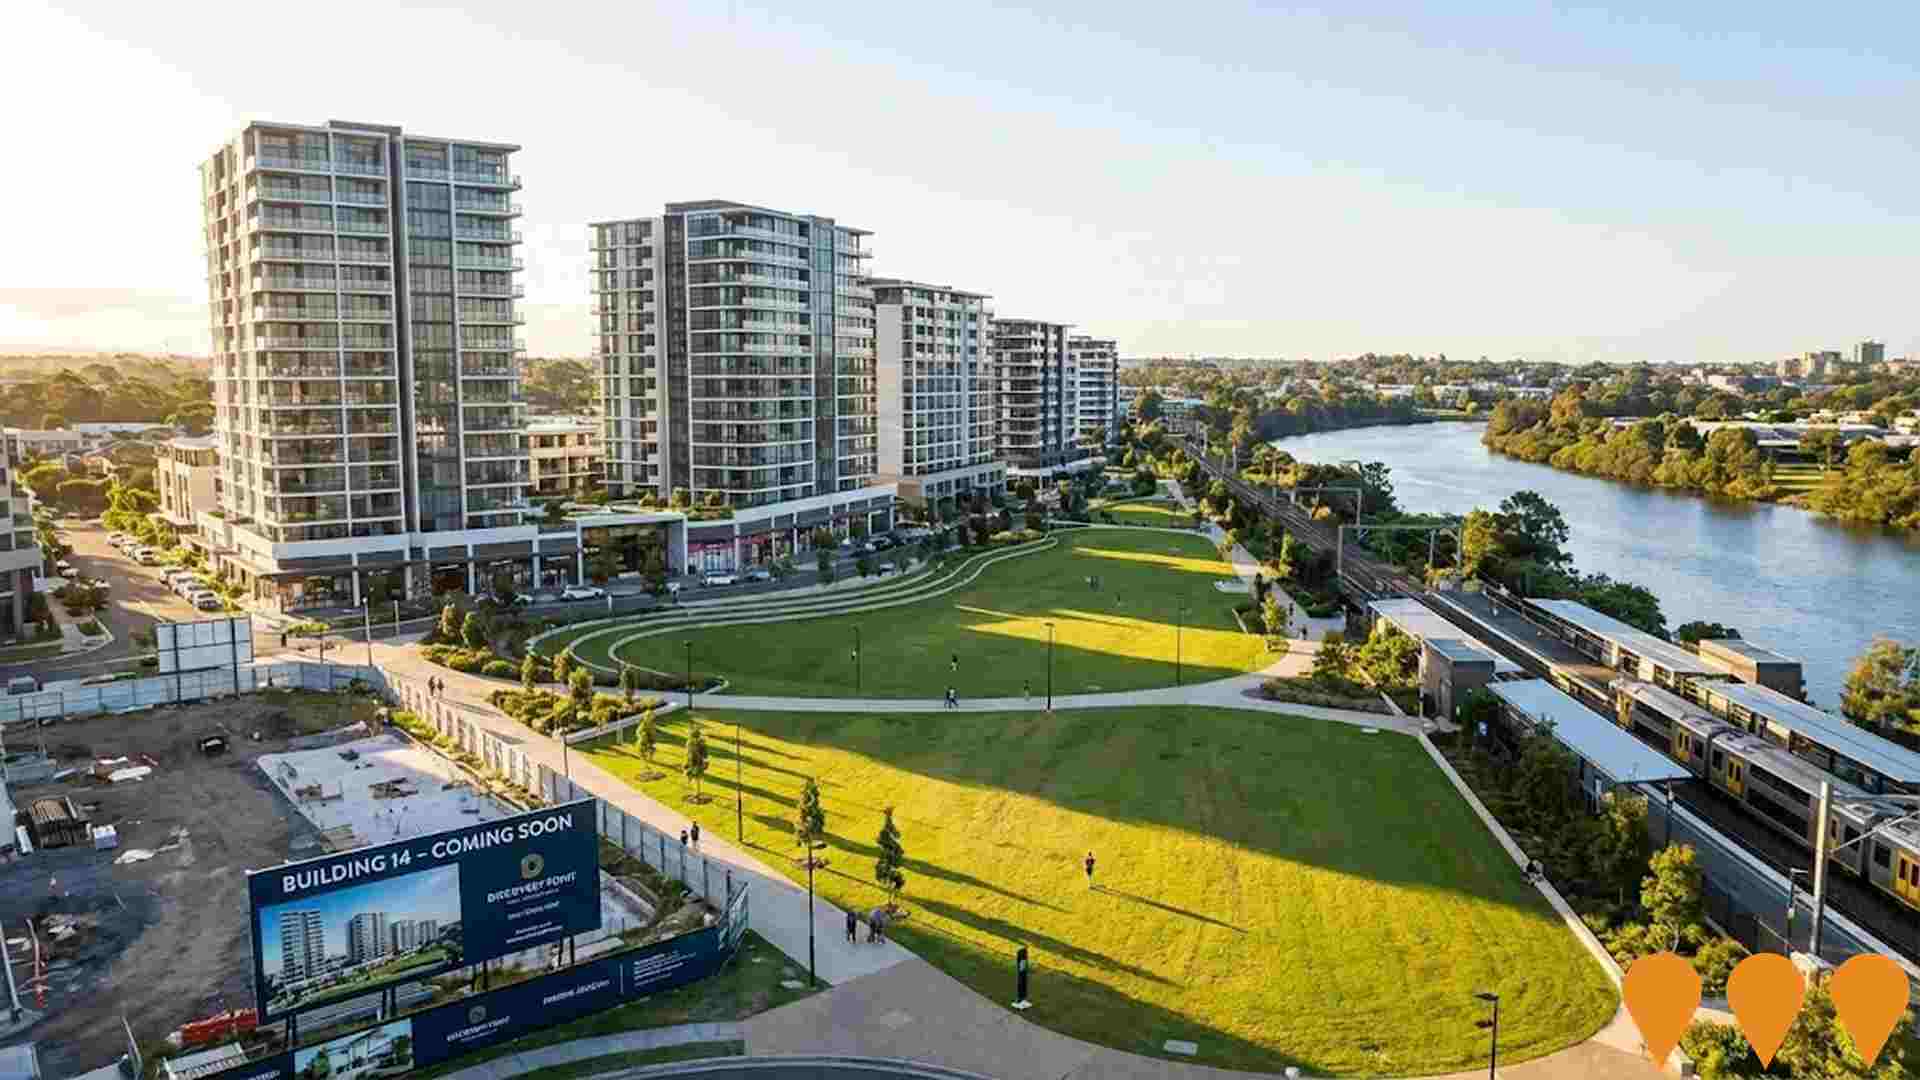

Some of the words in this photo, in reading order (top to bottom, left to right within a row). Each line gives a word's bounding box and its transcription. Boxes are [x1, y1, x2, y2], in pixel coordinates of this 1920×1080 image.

[282, 854, 386, 893] BUILDING
[391, 850, 412, 869] 14
[431, 825, 514, 859] COMING
[517, 813, 573, 840] SOON
